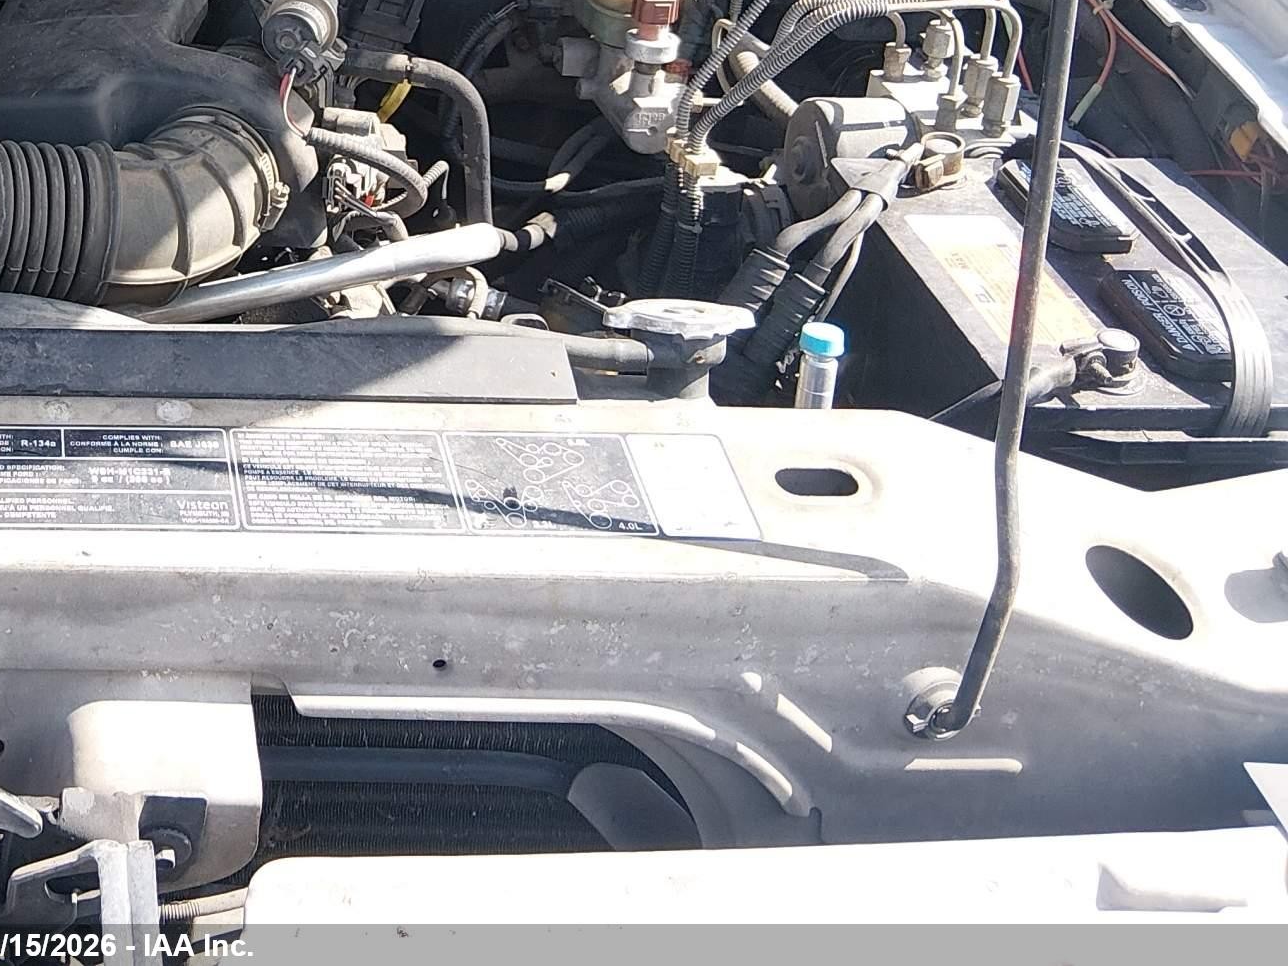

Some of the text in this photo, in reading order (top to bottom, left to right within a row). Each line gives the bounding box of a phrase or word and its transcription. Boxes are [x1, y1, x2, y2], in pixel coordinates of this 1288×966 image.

[1121, 279, 1154, 310] POISON
[170, 440, 192, 448] SAE
[176, 500, 228, 510] Visteon
[618, 522, 644, 530] 4.0L
